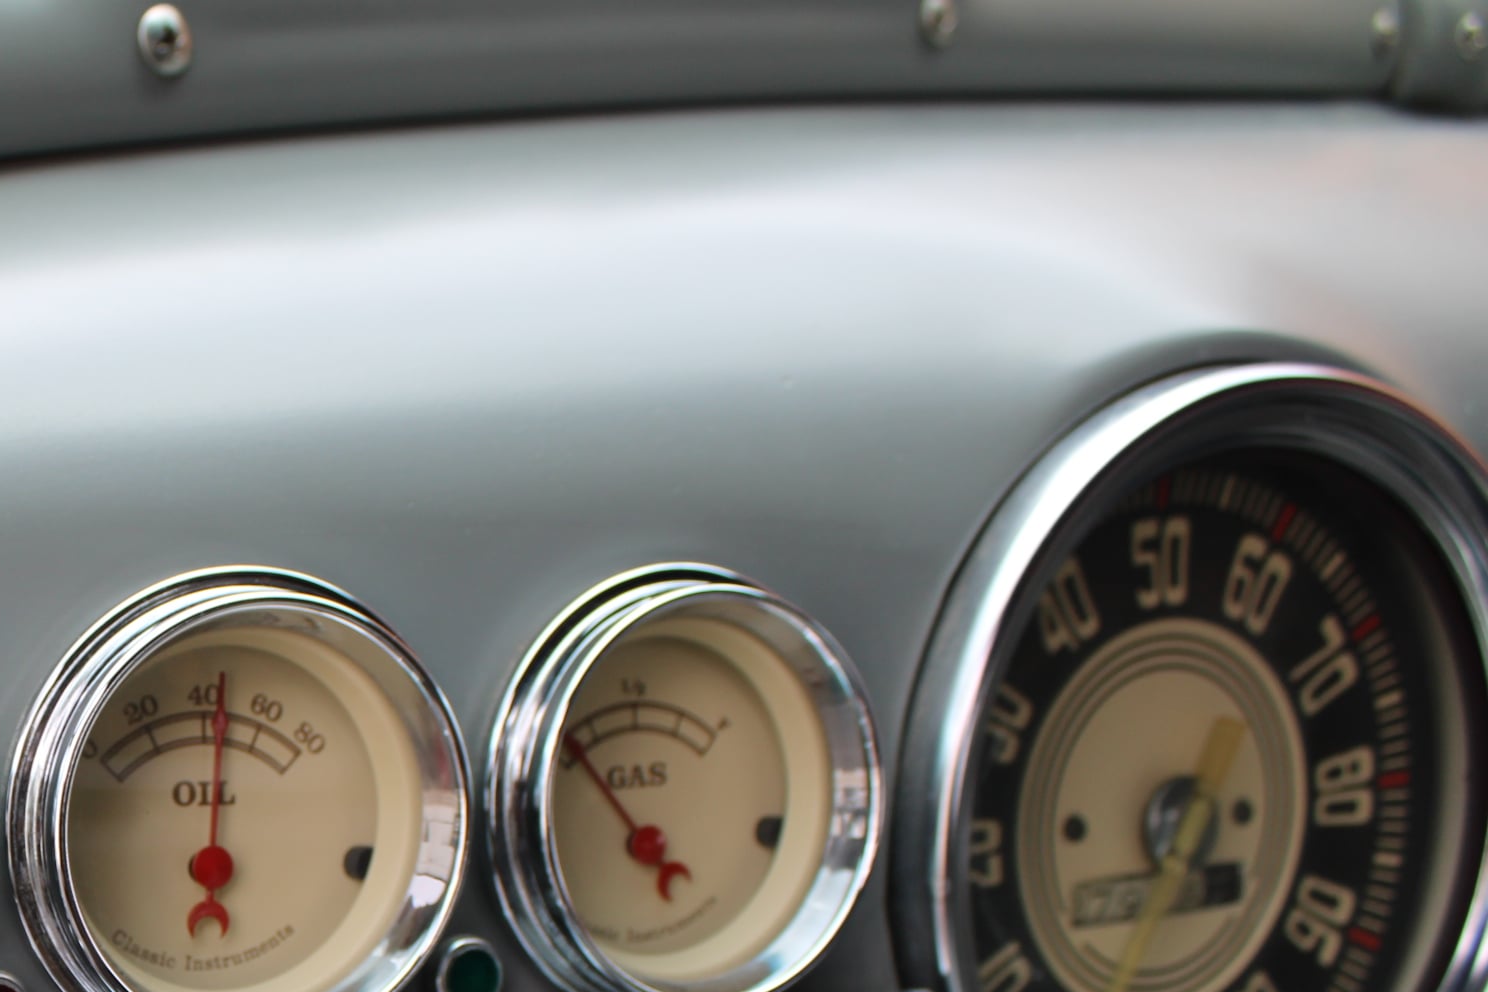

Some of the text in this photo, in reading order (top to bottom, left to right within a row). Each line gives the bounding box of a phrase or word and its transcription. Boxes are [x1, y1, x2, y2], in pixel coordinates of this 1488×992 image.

[1037, 553, 1102, 654] 40
[1130, 514, 1191, 609] 50
[1223, 532, 1293, 635] 60
[1289, 612, 1360, 716] 70
[123, 694, 159, 726] 20
[188, 683, 223, 706] 40
[250, 693, 283, 723] 60
[294, 721, 326, 755] 80
[172, 780, 236, 807] OIL
[607, 760, 668, 789] GAS
[1314, 744, 1375, 827] 80
[112, 924, 295, 971] Classic Instruments
[1284, 876, 1356, 968] 90
